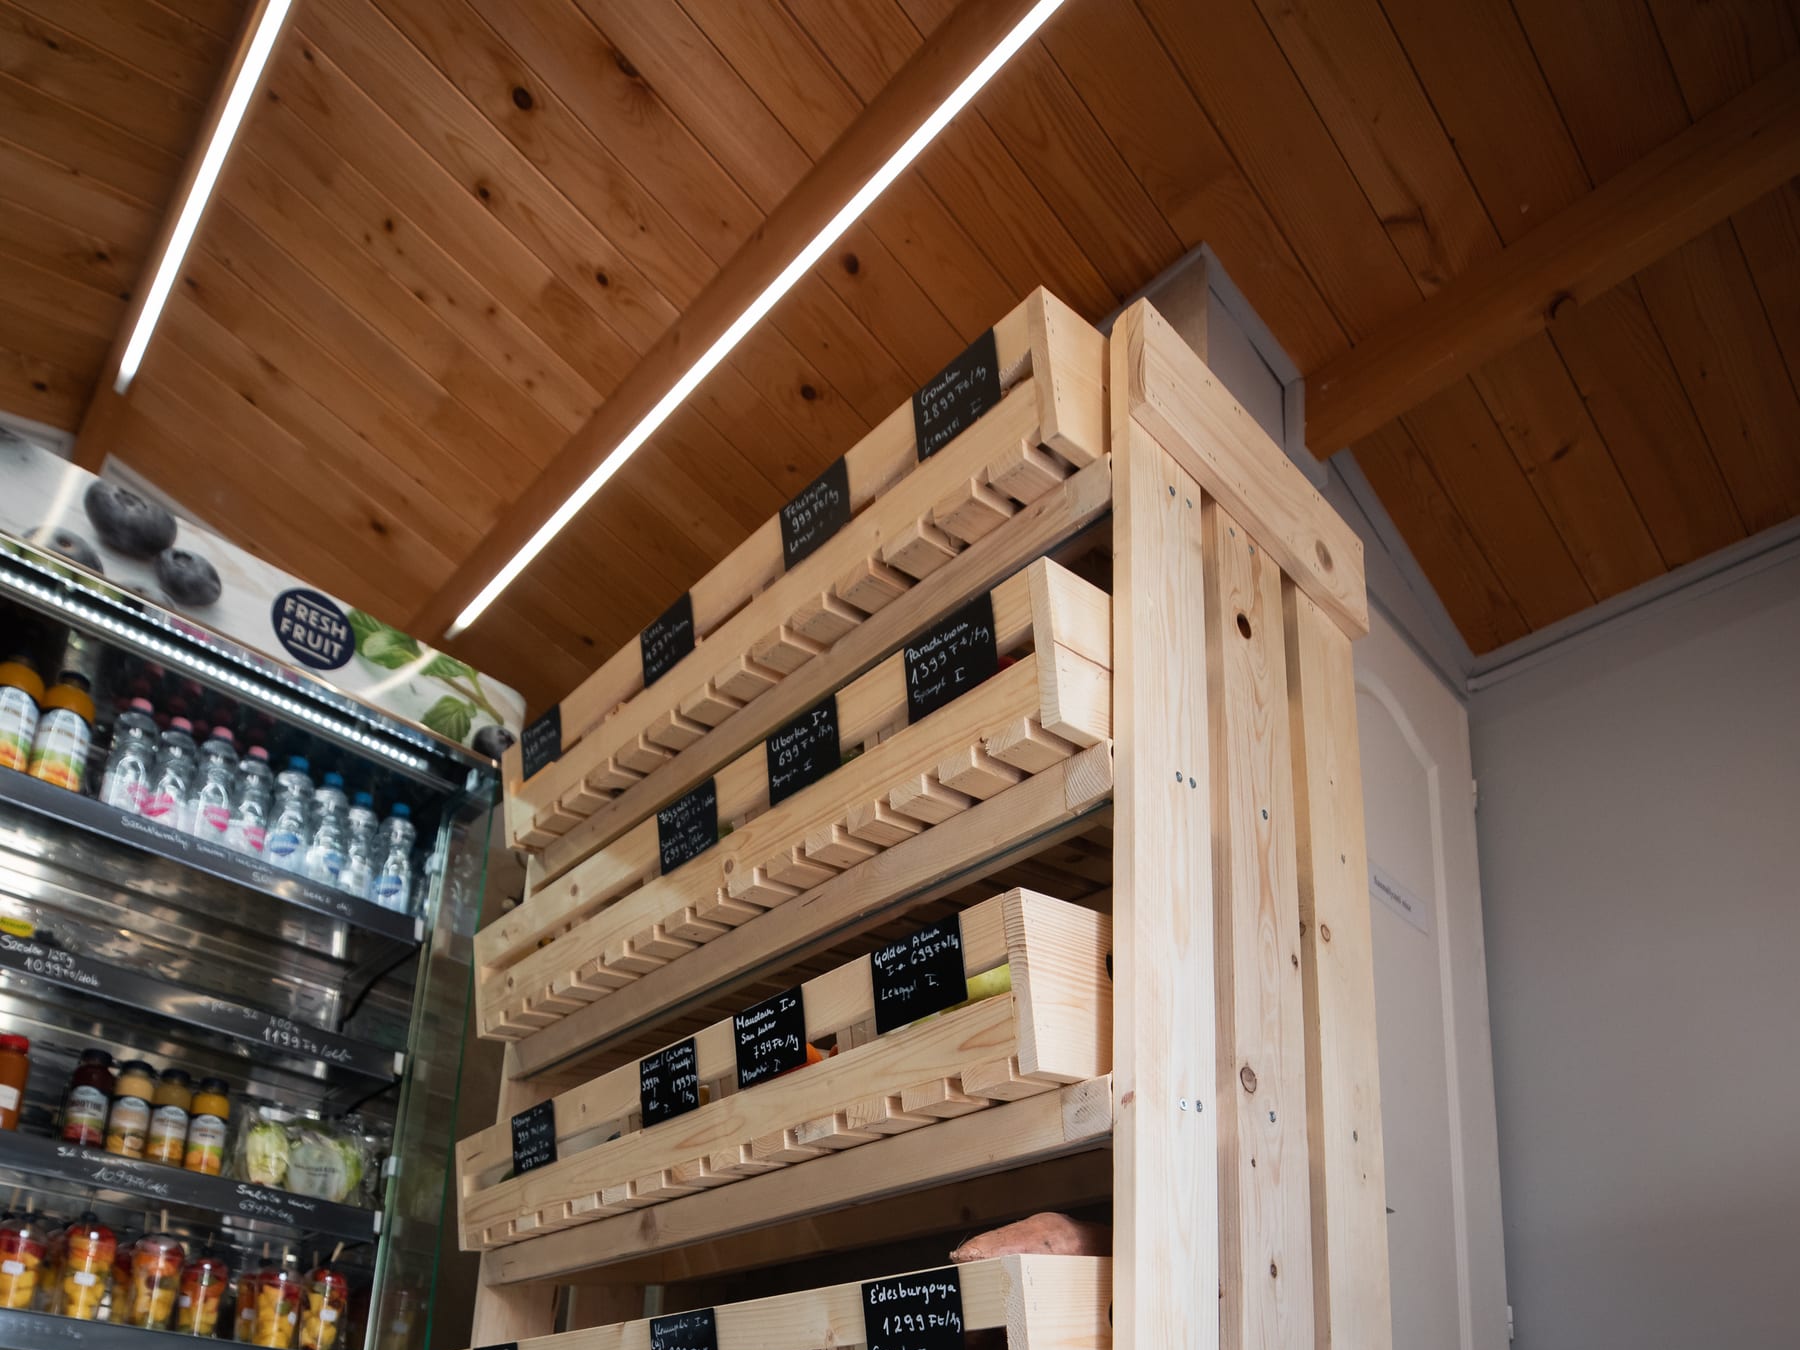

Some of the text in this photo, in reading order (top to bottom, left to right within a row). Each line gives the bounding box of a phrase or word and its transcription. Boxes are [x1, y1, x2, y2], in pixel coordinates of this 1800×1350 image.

[280, 617, 343, 659] FRUIT
[284, 597, 347, 642] FRESH
[883, 1313, 925, 1336] 1299
